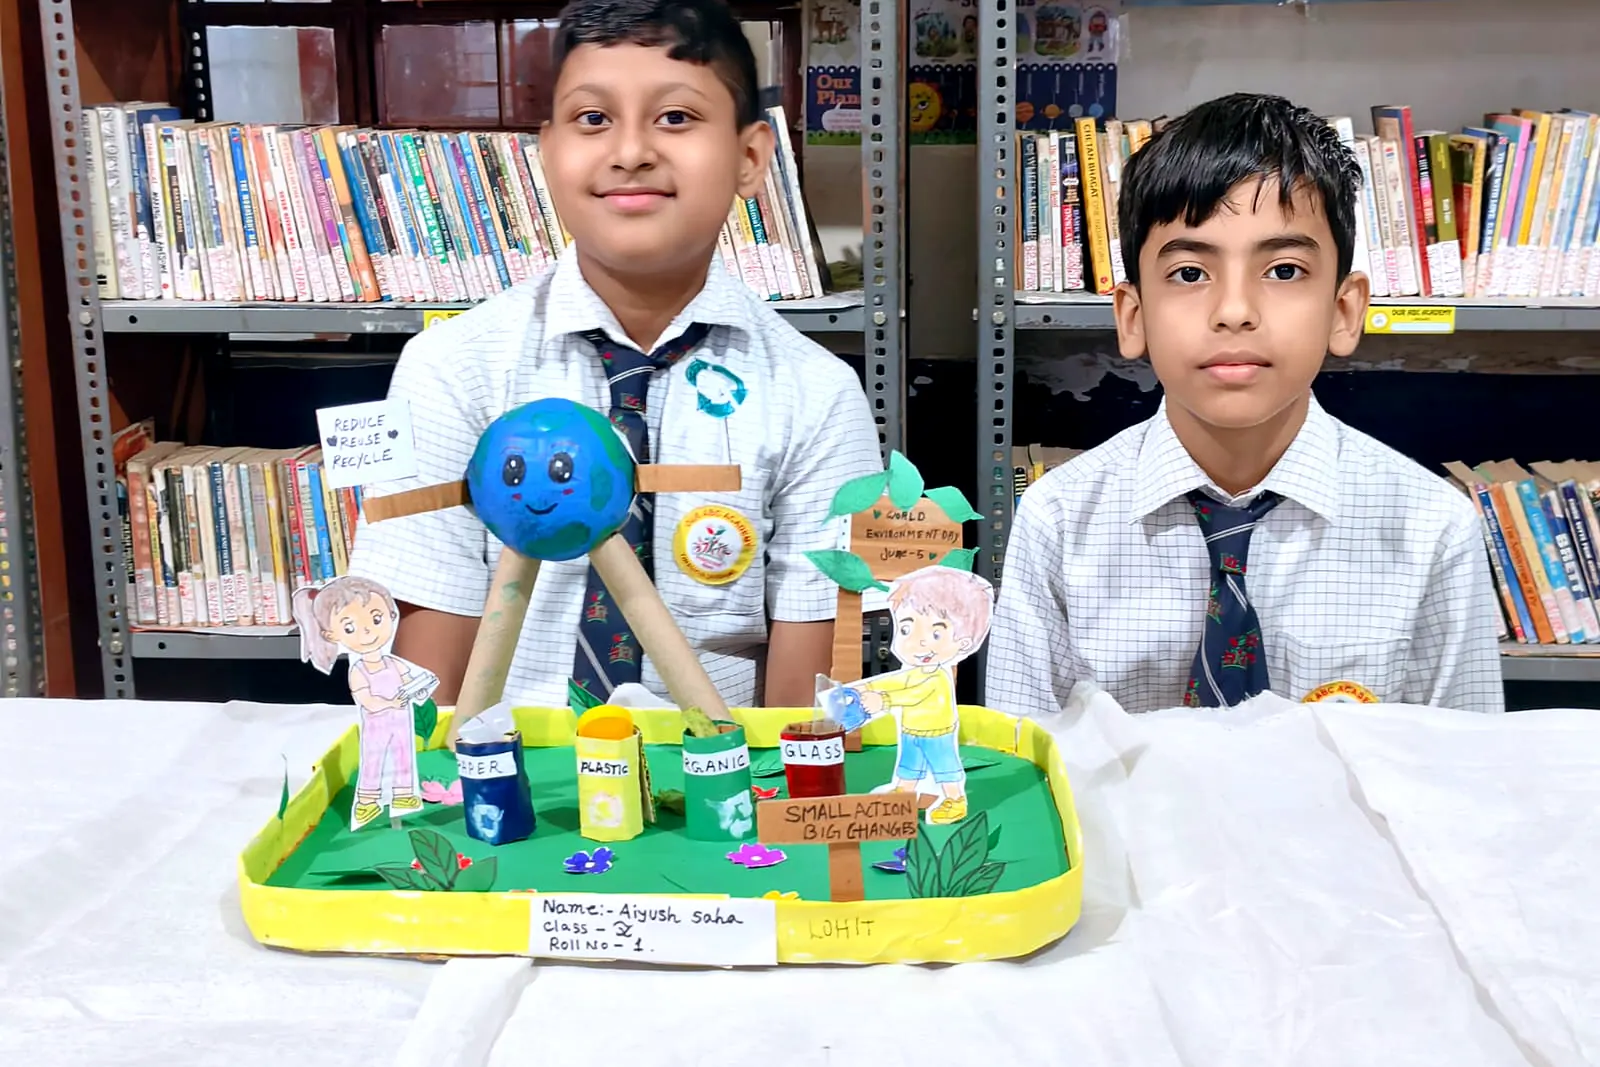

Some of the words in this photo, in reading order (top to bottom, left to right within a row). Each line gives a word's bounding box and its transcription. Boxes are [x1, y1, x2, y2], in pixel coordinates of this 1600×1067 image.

[816, 90, 861, 105] Plan
[1083, 124, 1093, 163] CHETAN
[1087, 164, 1098, 199] BHAGAT
[746, 198, 760, 227] Animal
[754, 228, 764, 244] Far
[1027, 194, 1038, 240] MISCHIE
[249, 233, 257, 246] MA
[335, 414, 385, 432] REDUCE
[340, 432, 381, 450] REUSE
[333, 449, 393, 469] RECYCLE
[886, 512, 926, 521] WORLD
[942, 530, 960, 544] DAY
[1555, 533, 1585, 592] BRETT
[785, 744, 842, 761] GLASS
[457, 760, 503, 775] APER
[581, 761, 629, 775] PLASTIC
[685, 755, 745, 773] RGANIC
[785, 803, 851, 822] SMALL
[855, 800, 912, 819] ACTION
[803, 823, 841, 840] BIG
[846, 821, 916, 840] CHANGES
[620, 903, 682, 923] Aiyush
[808, 916, 875, 940] LOHIT
[549, 936, 580, 951] Roll
